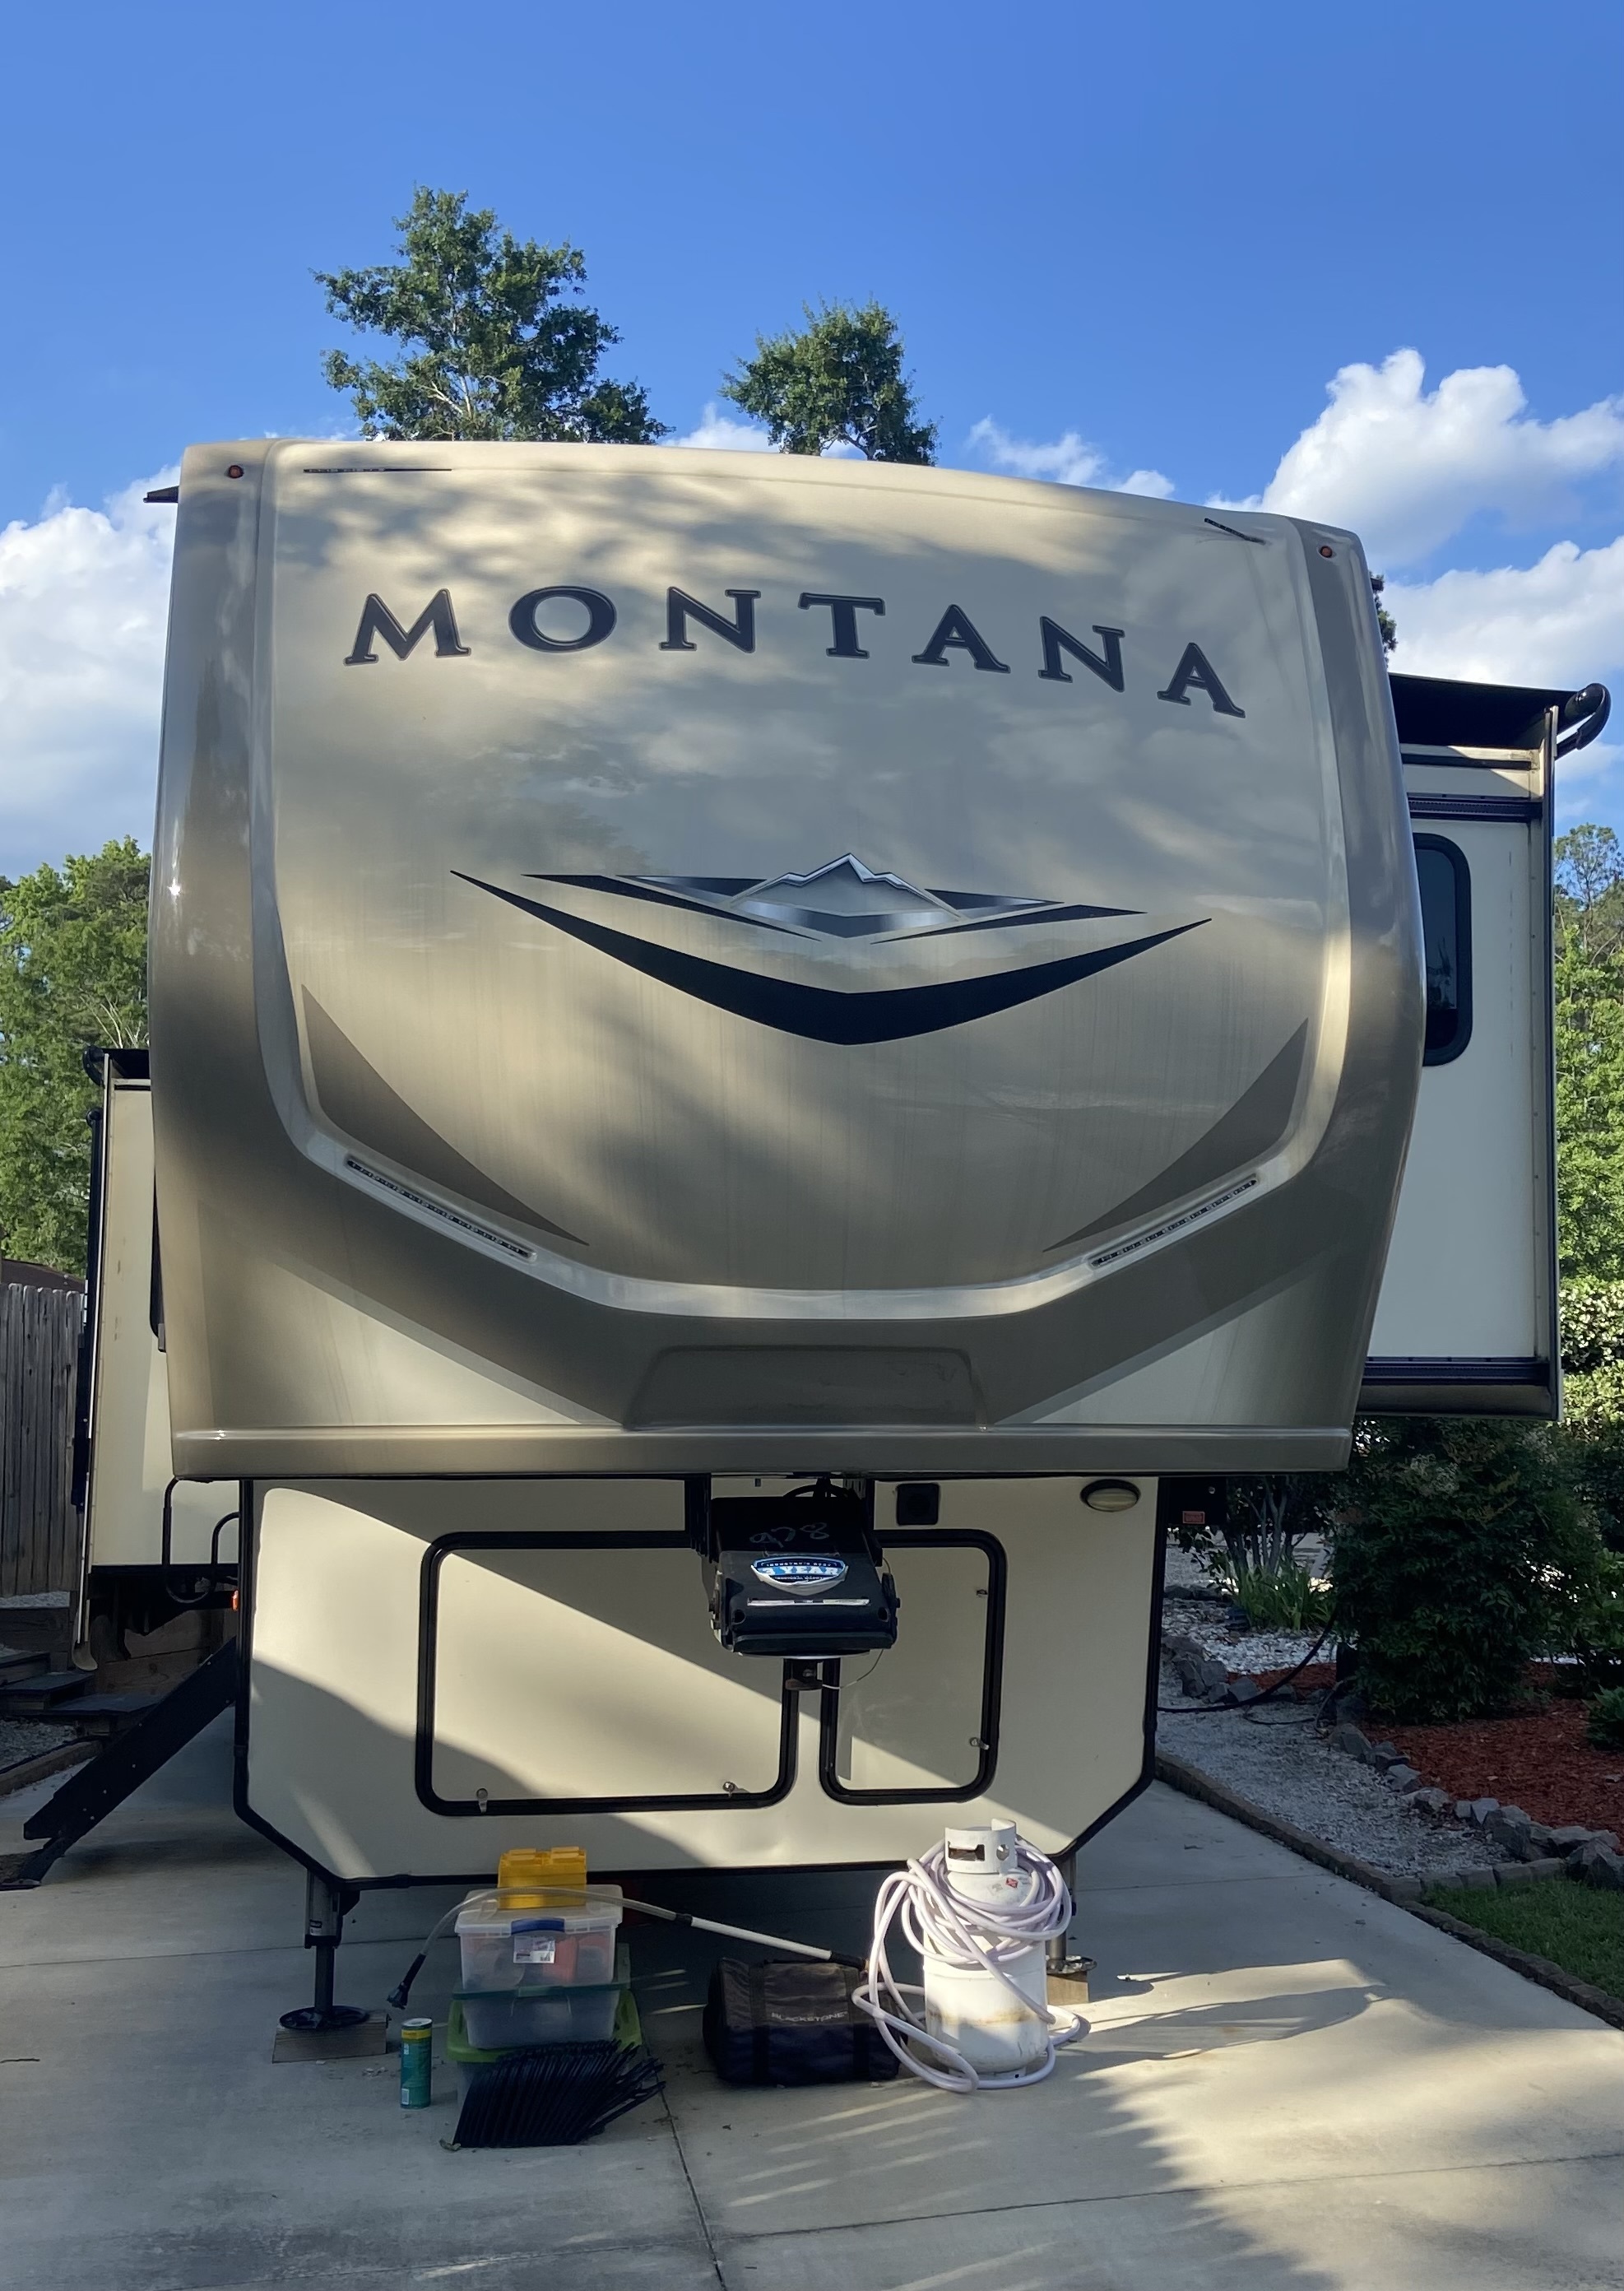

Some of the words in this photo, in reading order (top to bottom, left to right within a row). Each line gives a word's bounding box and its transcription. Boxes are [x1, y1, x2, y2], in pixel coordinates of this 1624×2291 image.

[344, 585, 1246, 718] MONTANA
[780, 1566, 839, 1576] YEAR
[771, 2011, 845, 2023] BLACKSTONE
